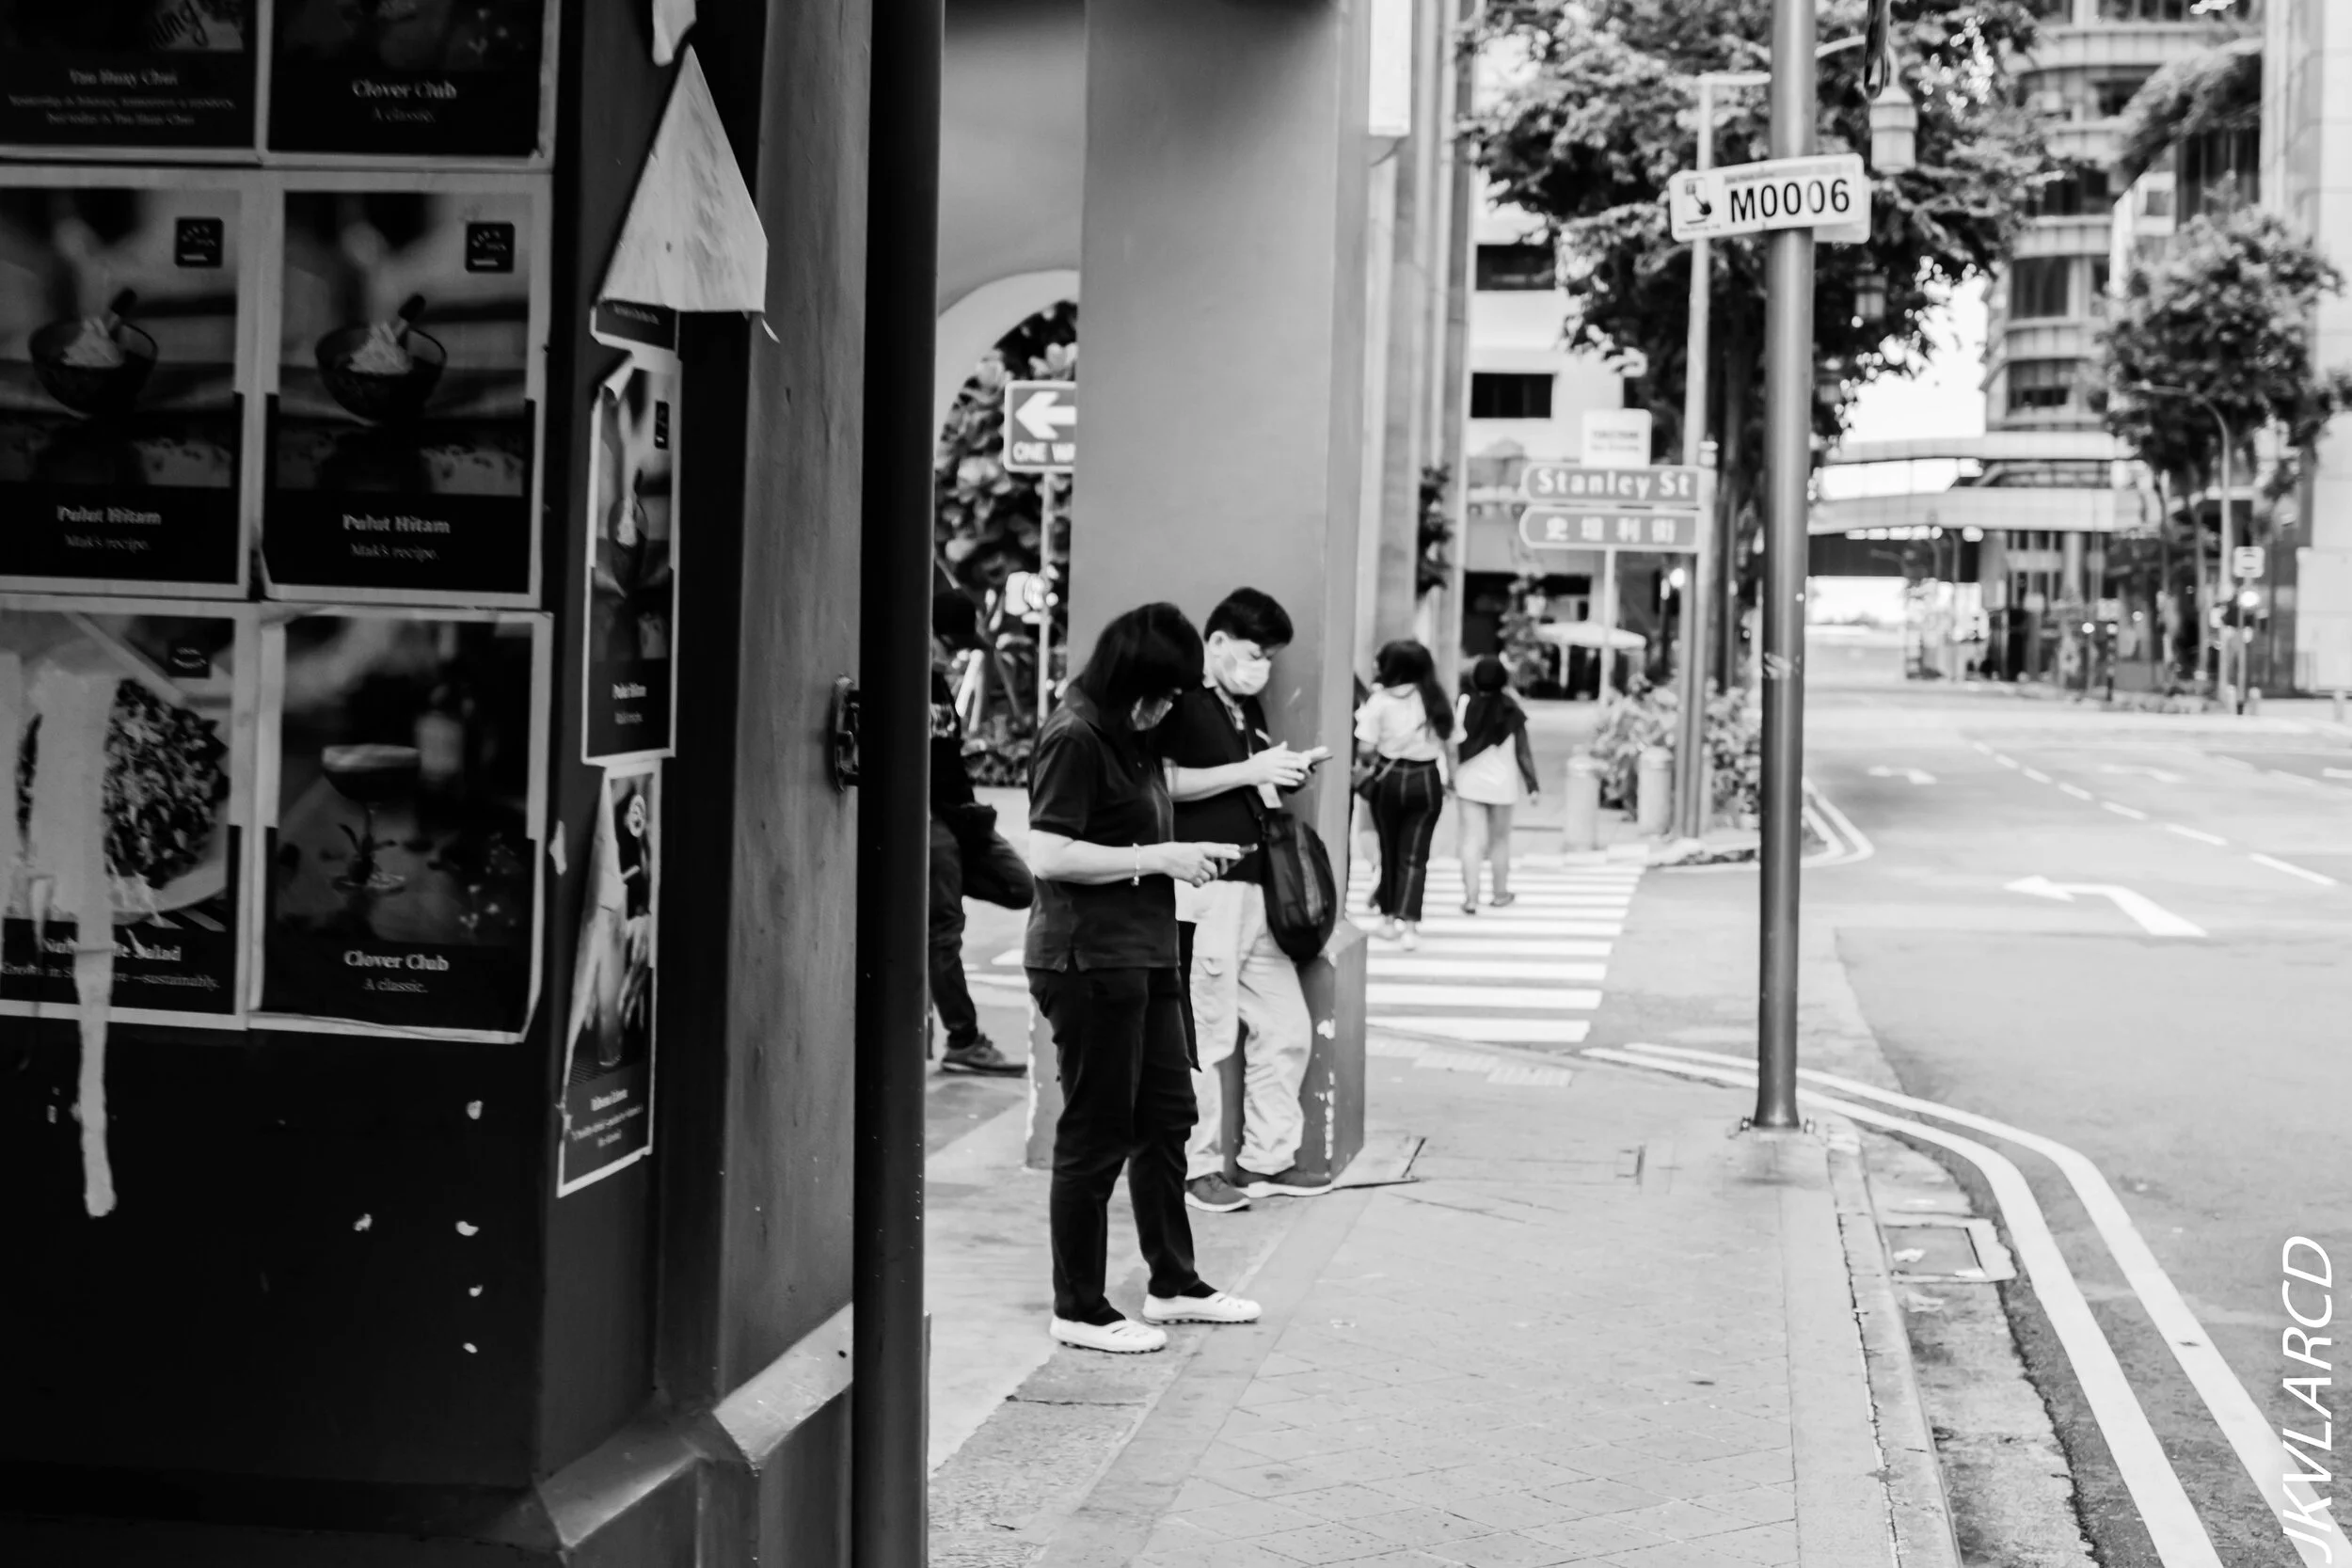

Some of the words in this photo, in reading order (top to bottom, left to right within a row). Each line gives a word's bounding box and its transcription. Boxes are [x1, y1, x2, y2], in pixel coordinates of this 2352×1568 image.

[352, 78, 412, 99] Clover
[415, 79, 457, 100] Club
[1730, 178, 1851, 224] M0006
[1012, 440, 1046, 463] ONE
[1537, 467, 1650, 500] Stanley
[1659, 470, 1690, 498] St
[56, 504, 104, 524] Pulut
[106, 505, 163, 526] Hitam
[342, 512, 391, 532] Pulut
[394, 515, 452, 534] Hitam
[342, 949, 403, 969] Clover
[405, 953, 450, 972] Club
